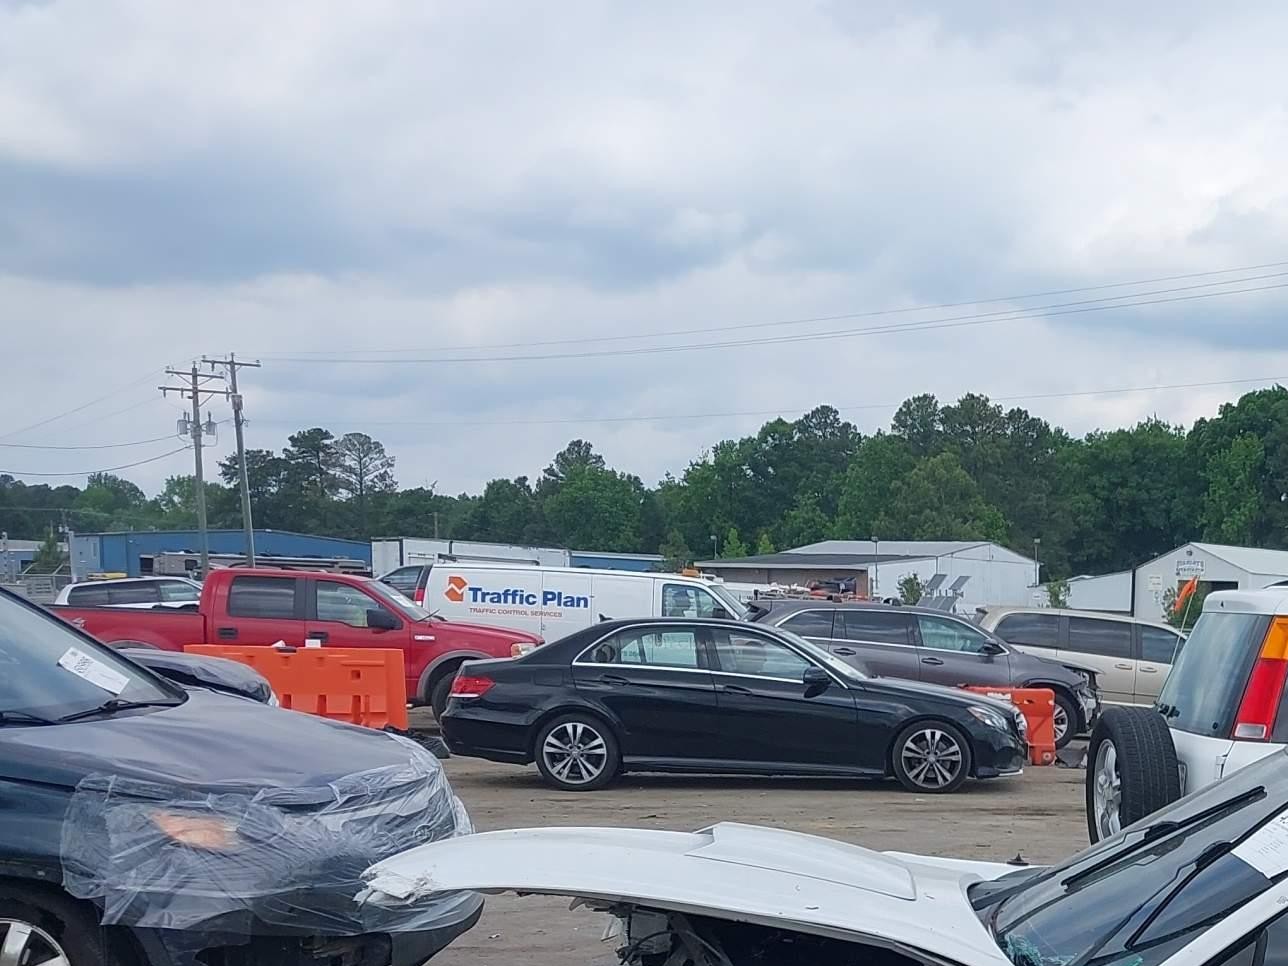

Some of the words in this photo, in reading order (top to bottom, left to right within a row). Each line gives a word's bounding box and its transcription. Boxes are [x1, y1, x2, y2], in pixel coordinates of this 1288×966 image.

[468, 587, 537, 606] Traffic
[542, 590, 589, 608] Plan
[470, 607, 496, 615] TRAFFIC
[497, 608, 529, 617] CONTROL
[530, 610, 563, 618] SERVICES
